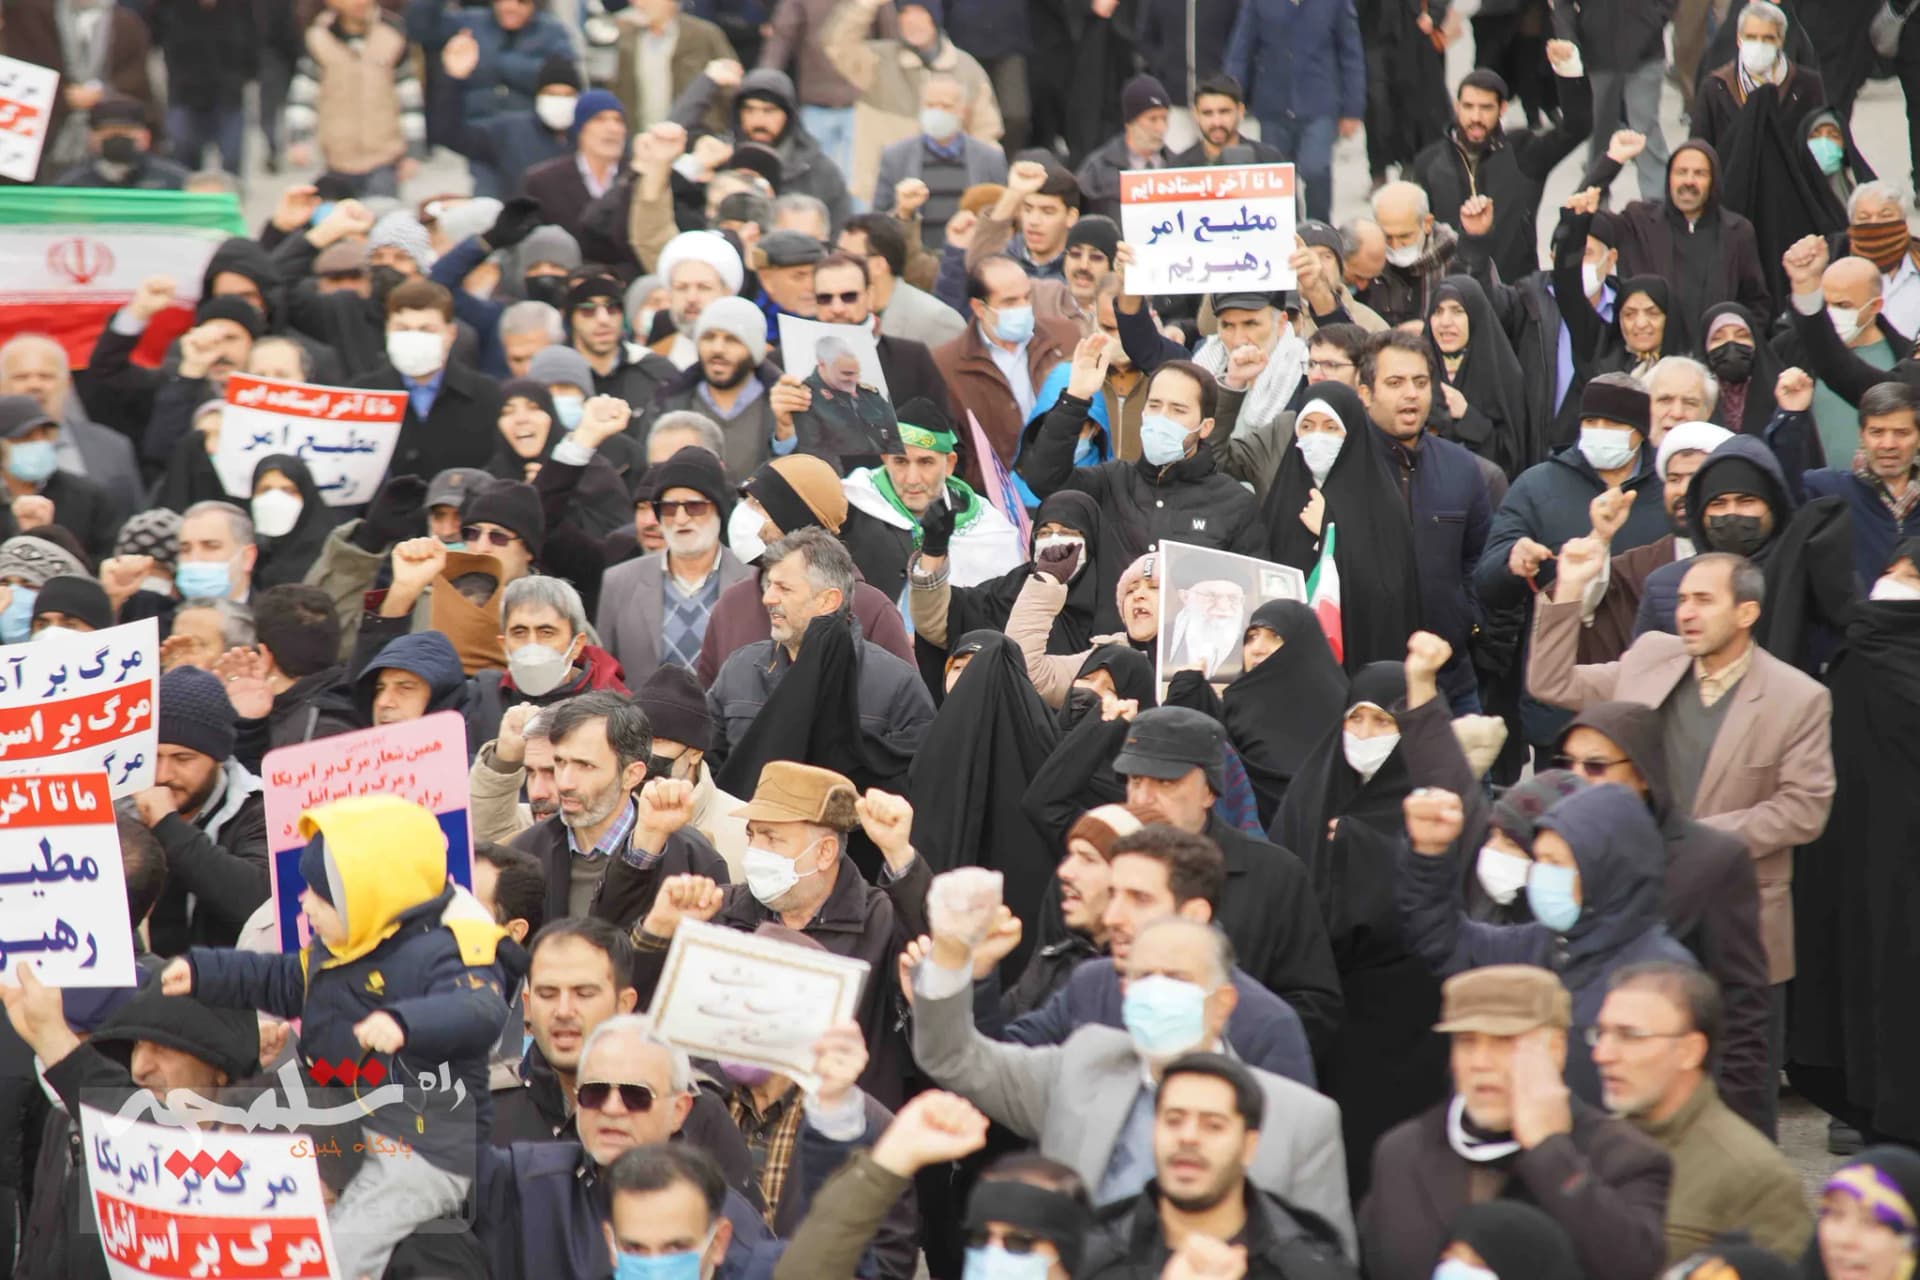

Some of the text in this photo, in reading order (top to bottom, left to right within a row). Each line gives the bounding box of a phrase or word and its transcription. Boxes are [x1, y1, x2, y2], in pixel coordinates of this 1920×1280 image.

[1130, 170, 1284, 201] ما تا آخر ایستاده ایم
[1146, 204, 1278, 245] مطیع امر
[1168, 252, 1272, 284] رهبریم
[1192, 519, 1206, 531] W
[42, 664, 68, 698] بر
[79, 645, 143, 684] مرگ
[52, 713, 82, 751] بر
[87, 694, 151, 734] مرگ
[271, 761, 318, 788] آمریکا
[48, 780, 69, 812] تا
[71, 779, 97, 812] ما
[94, 1134, 161, 1195] آمریکا
[214, 1160, 297, 1209] مرگ
[102, 1200, 180, 1270] اسرائیل
[228, 1223, 323, 1277] مرگ
[189, 1231, 221, 1278] بر
